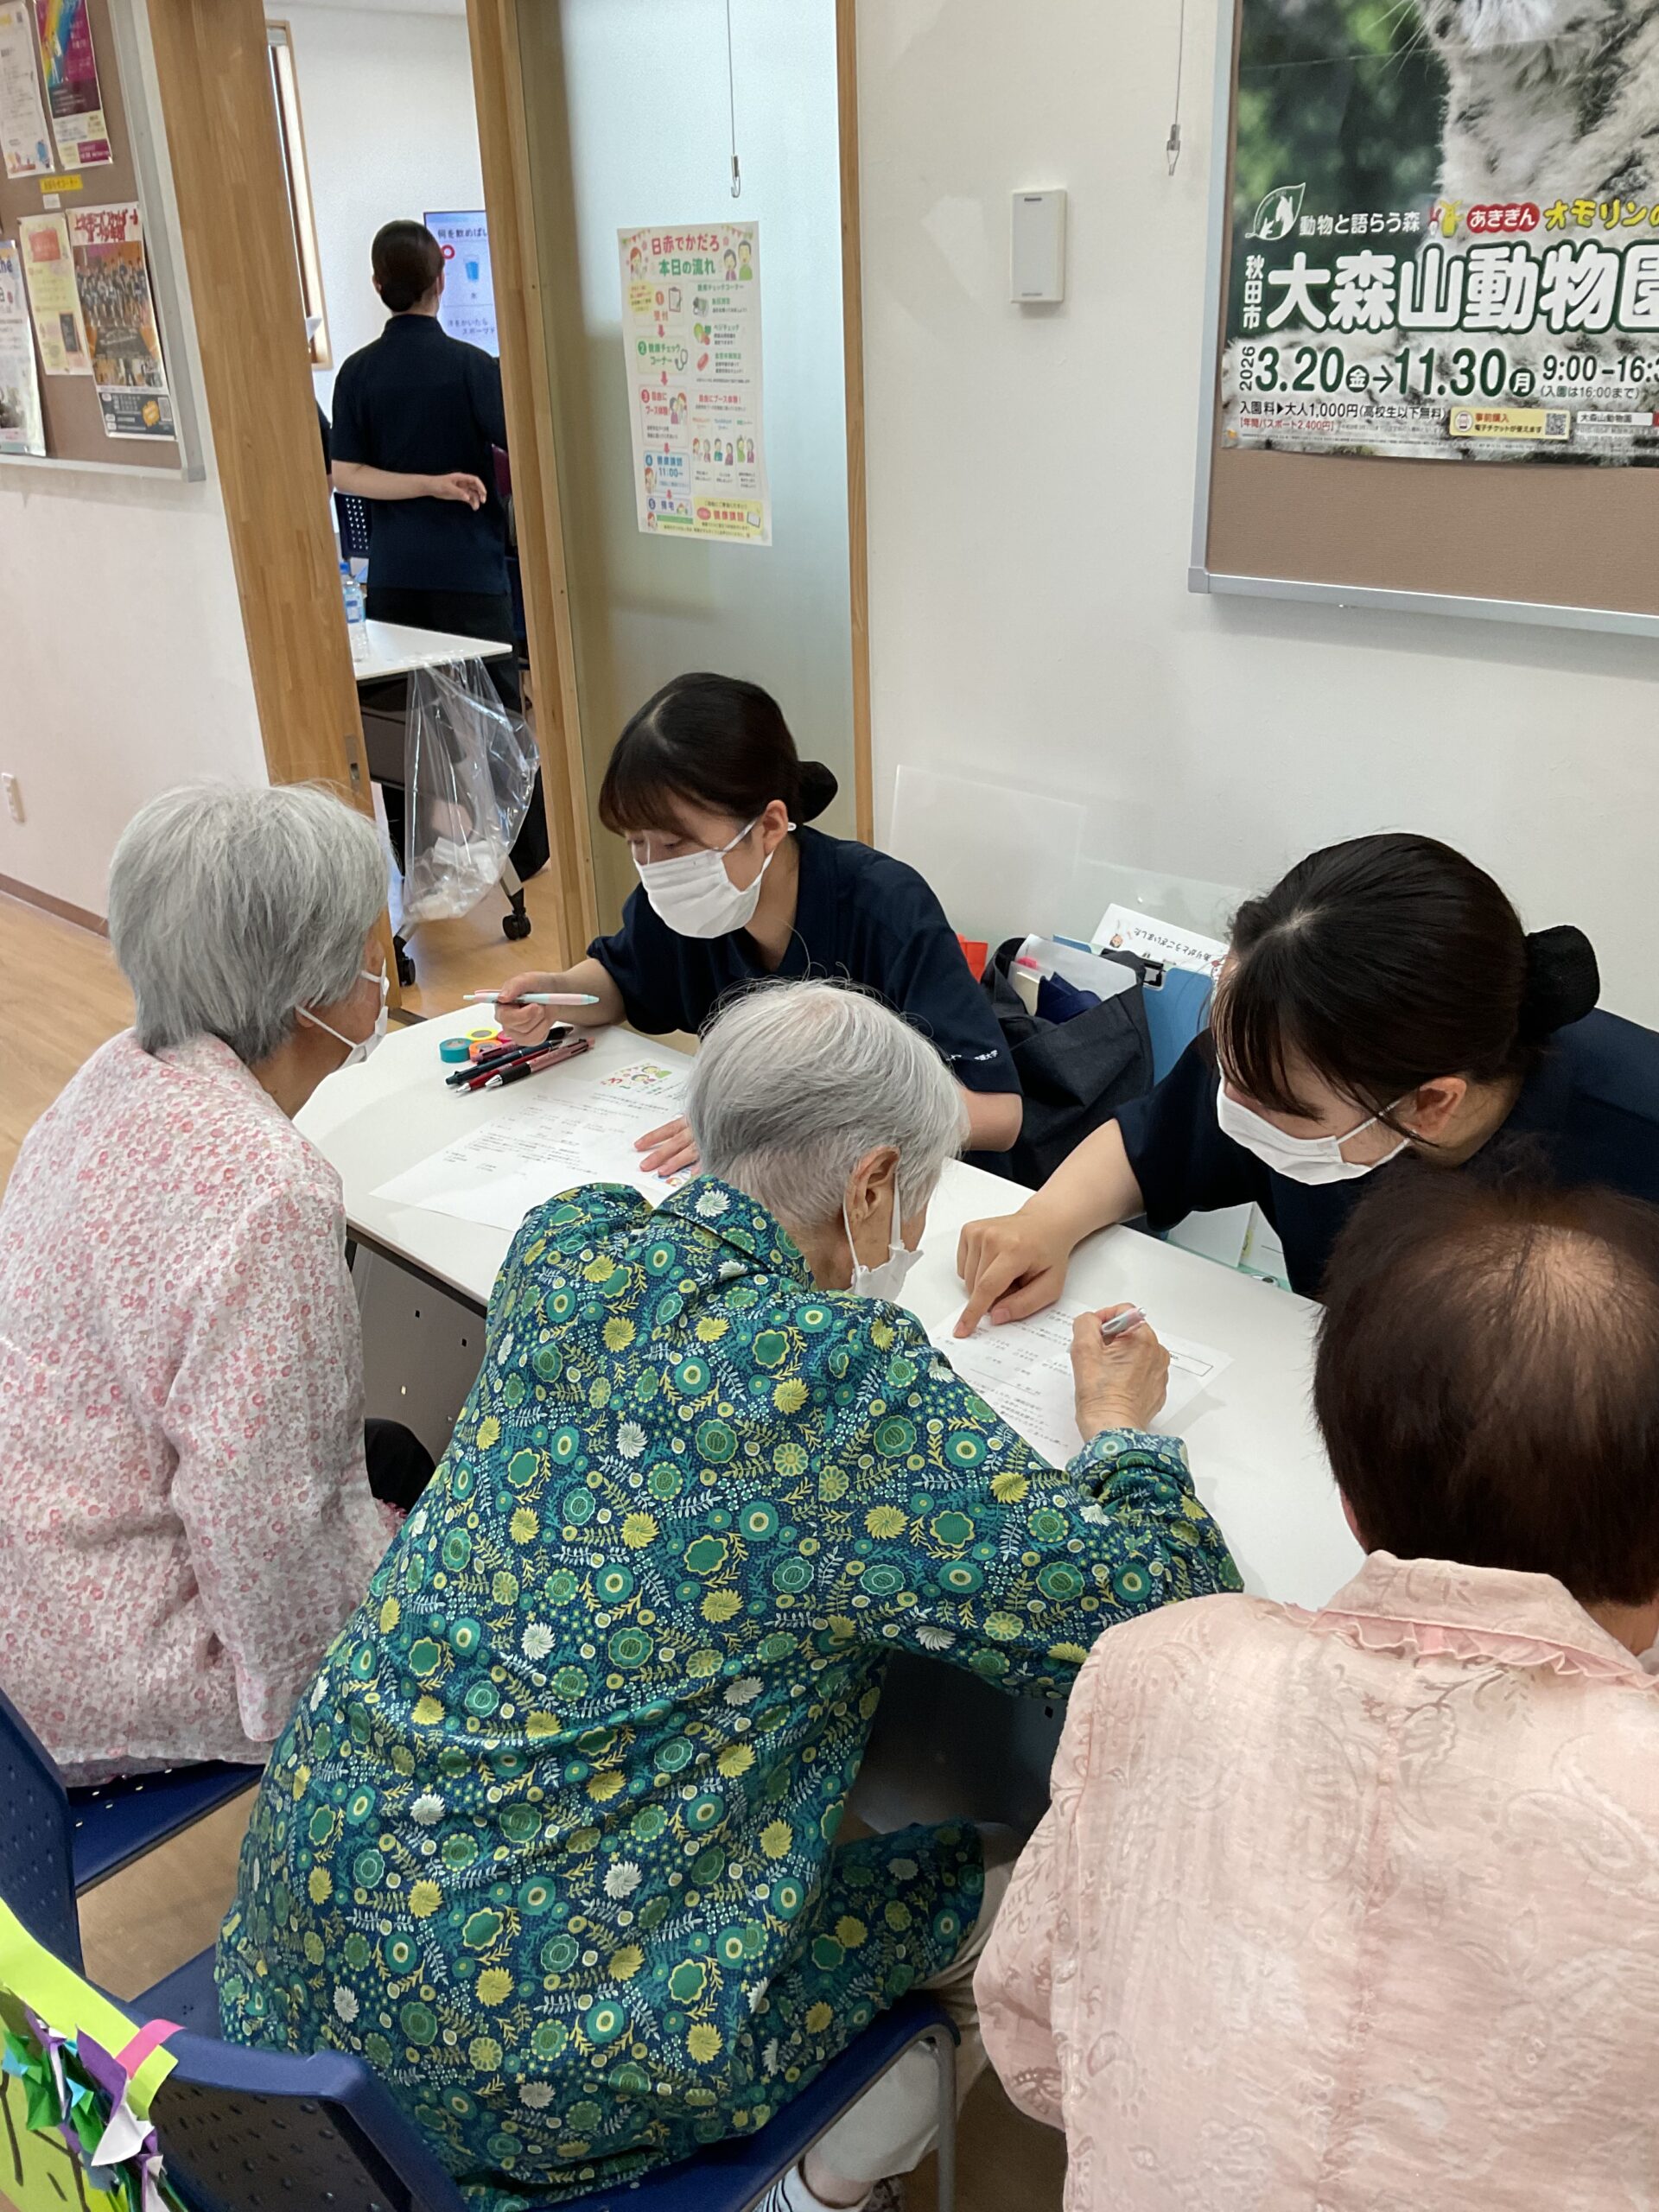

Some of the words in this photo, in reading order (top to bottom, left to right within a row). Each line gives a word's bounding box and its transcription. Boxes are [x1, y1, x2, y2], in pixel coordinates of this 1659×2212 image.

[1299, 211, 1421, 236] 動物と語らう森
[1470, 207, 1535, 228] あきぎん
[658, 257, 715, 276] 本日の流れ
[1243, 254, 1265, 329] 秋田市
[1239, 346, 1255, 391] 2026
[1255, 346, 1344, 393] 3.20
[1395, 347, 1507, 397] 11.30
[1239, 400, 1274, 416] 入園料
[1133, 927, 1212, 963] ありがとうございました
